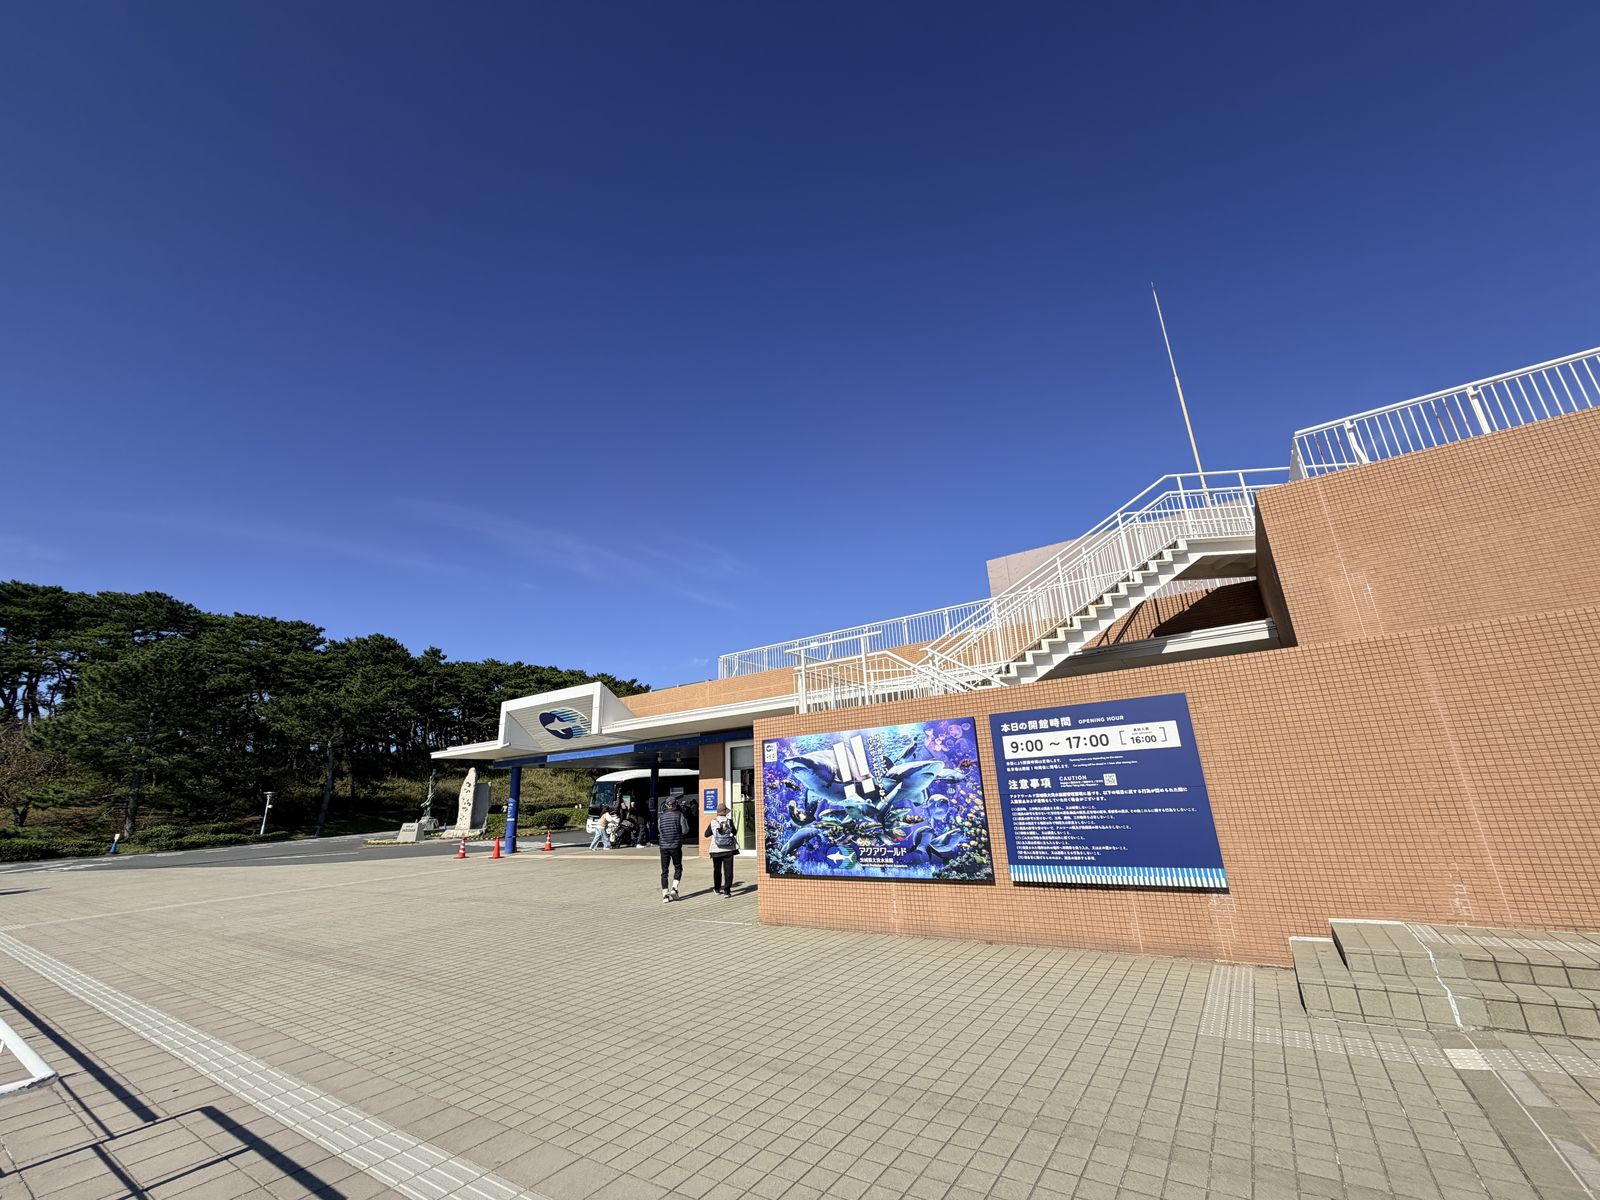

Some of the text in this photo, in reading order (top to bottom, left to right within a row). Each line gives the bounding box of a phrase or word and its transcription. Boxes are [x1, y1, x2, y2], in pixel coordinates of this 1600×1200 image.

[1000, 717, 1072, 733] 本日の開館時間
[1078, 716, 1105, 725] OPENING
[1010, 739, 1043, 753] 9:00
[1065, 734, 1109, 749] 17:00
[1130, 734, 1157, 744] 16:00
[1008, 778, 1052, 790] 注意事項
[859, 847, 907, 857] アクアワールド
